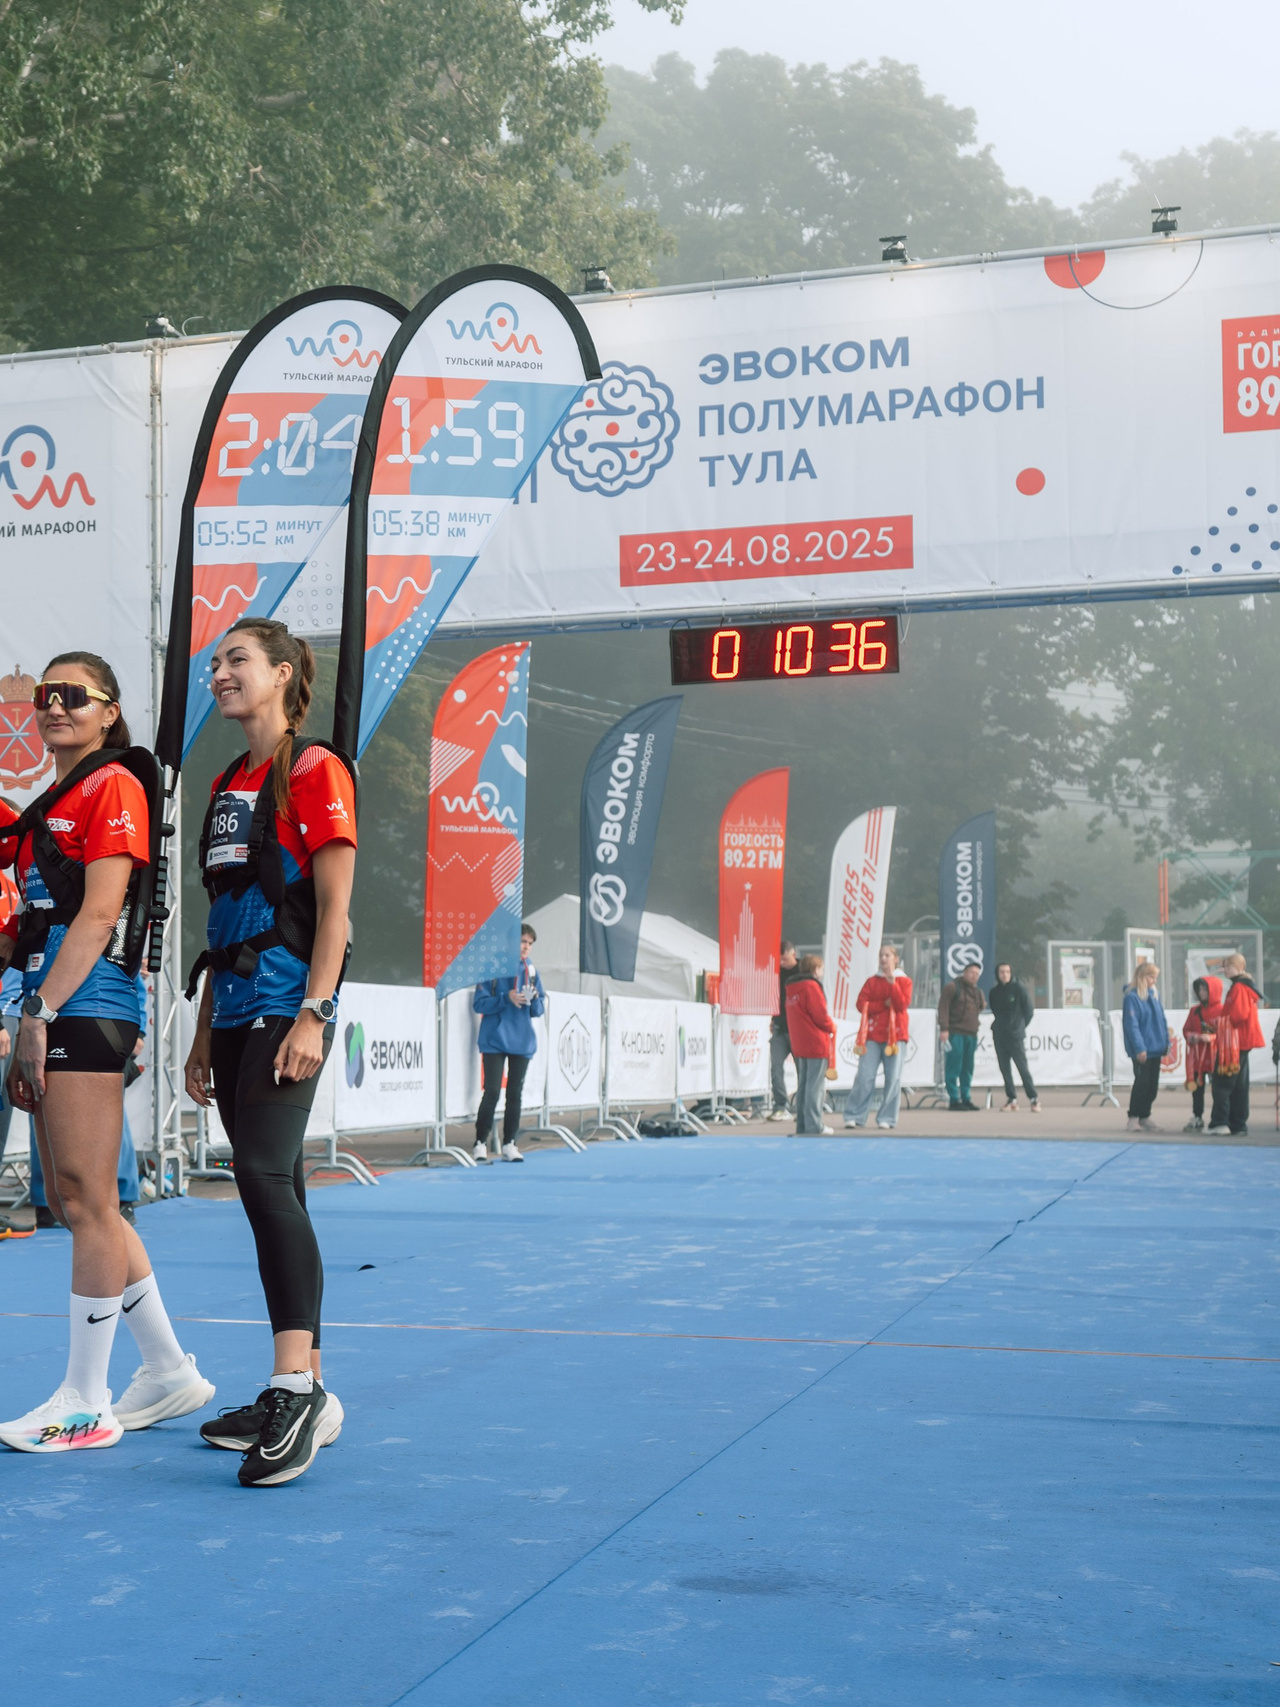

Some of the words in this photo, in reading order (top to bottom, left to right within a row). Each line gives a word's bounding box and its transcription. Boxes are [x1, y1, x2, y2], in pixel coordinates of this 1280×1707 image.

[445, 356, 494, 367] ТУЛЬСКИЙ
[496, 360, 543, 370] МАРАФОН
[698, 336, 910, 386] ЭВОКОМ
[283, 371, 334, 381] ТУЛЬСКИЙ
[336, 374, 376, 383] МАРАФ
[698, 376, 1045, 438] ПОЛУМАРАФОН
[218, 412, 364, 477] 2:04
[386, 397, 525, 468] 1:59
[699, 448, 818, 487] ТУЛА
[21, 519, 96, 537] МАРАФОН
[197, 519, 268, 546] 05:52
[372, 510, 440, 537] 05:38
[636, 526, 895, 573] 23-24.08.2025
[711, 630, 741, 679] 0
[774, 625, 814, 675] 10
[829, 620, 887, 673] 36
[596, 732, 640, 864] ЭВОКОМ
[440, 824, 479, 833] ТУЛЬСКИЙ
[480, 826, 518, 834] МАРАФОН
[724, 833, 784, 848] ГОРДОСТЬ
[724, 848, 756, 869] 89.2
[759, 849, 783, 869] FM
[862, 858, 877, 882] 71
[956, 841, 973, 937] ЭВОКОМ
[838, 863, 860, 978] RUNNERS
[856, 881, 874, 948] CLUB
[370, 1040, 424, 1070] ЭВОКОМ
[621, 1030, 666, 1055] K-HOLDING
[977, 1034, 1073, 1051] K-DING
